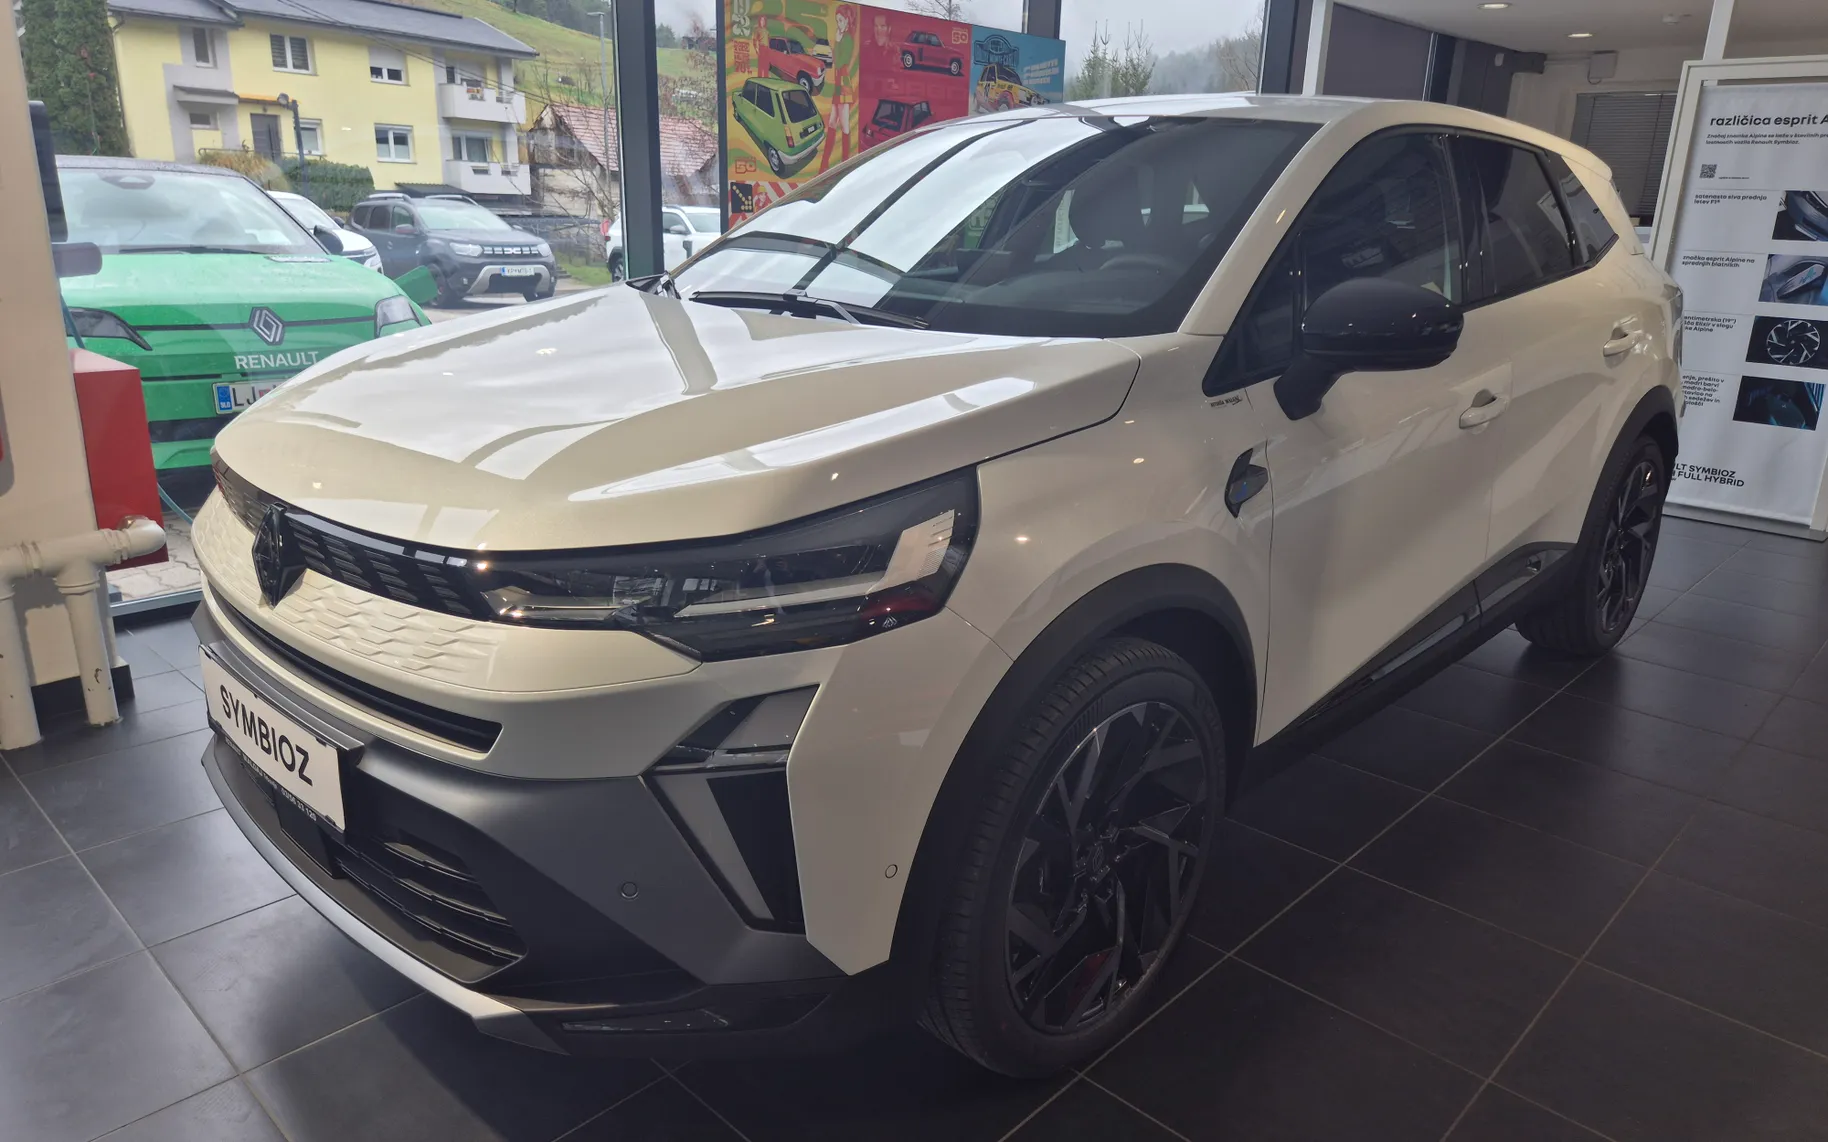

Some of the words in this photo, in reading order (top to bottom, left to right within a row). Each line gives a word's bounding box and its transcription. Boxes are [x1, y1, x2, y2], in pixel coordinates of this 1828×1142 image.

[1710, 115, 1771, 126] različica
[1774, 113, 1818, 127] esprit
[1711, 260, 1740, 268] blatnikih
[1717, 322, 1734, 330] slogu
[234, 351, 319, 370] RENAULT
[1698, 375, 1719, 383] prešito
[1689, 464, 1737, 479] SYMBIOZ
[1678, 471, 1702, 481] FULL
[1704, 475, 1744, 487] HYBRID
[220, 684, 313, 787] SYMBIOZ
